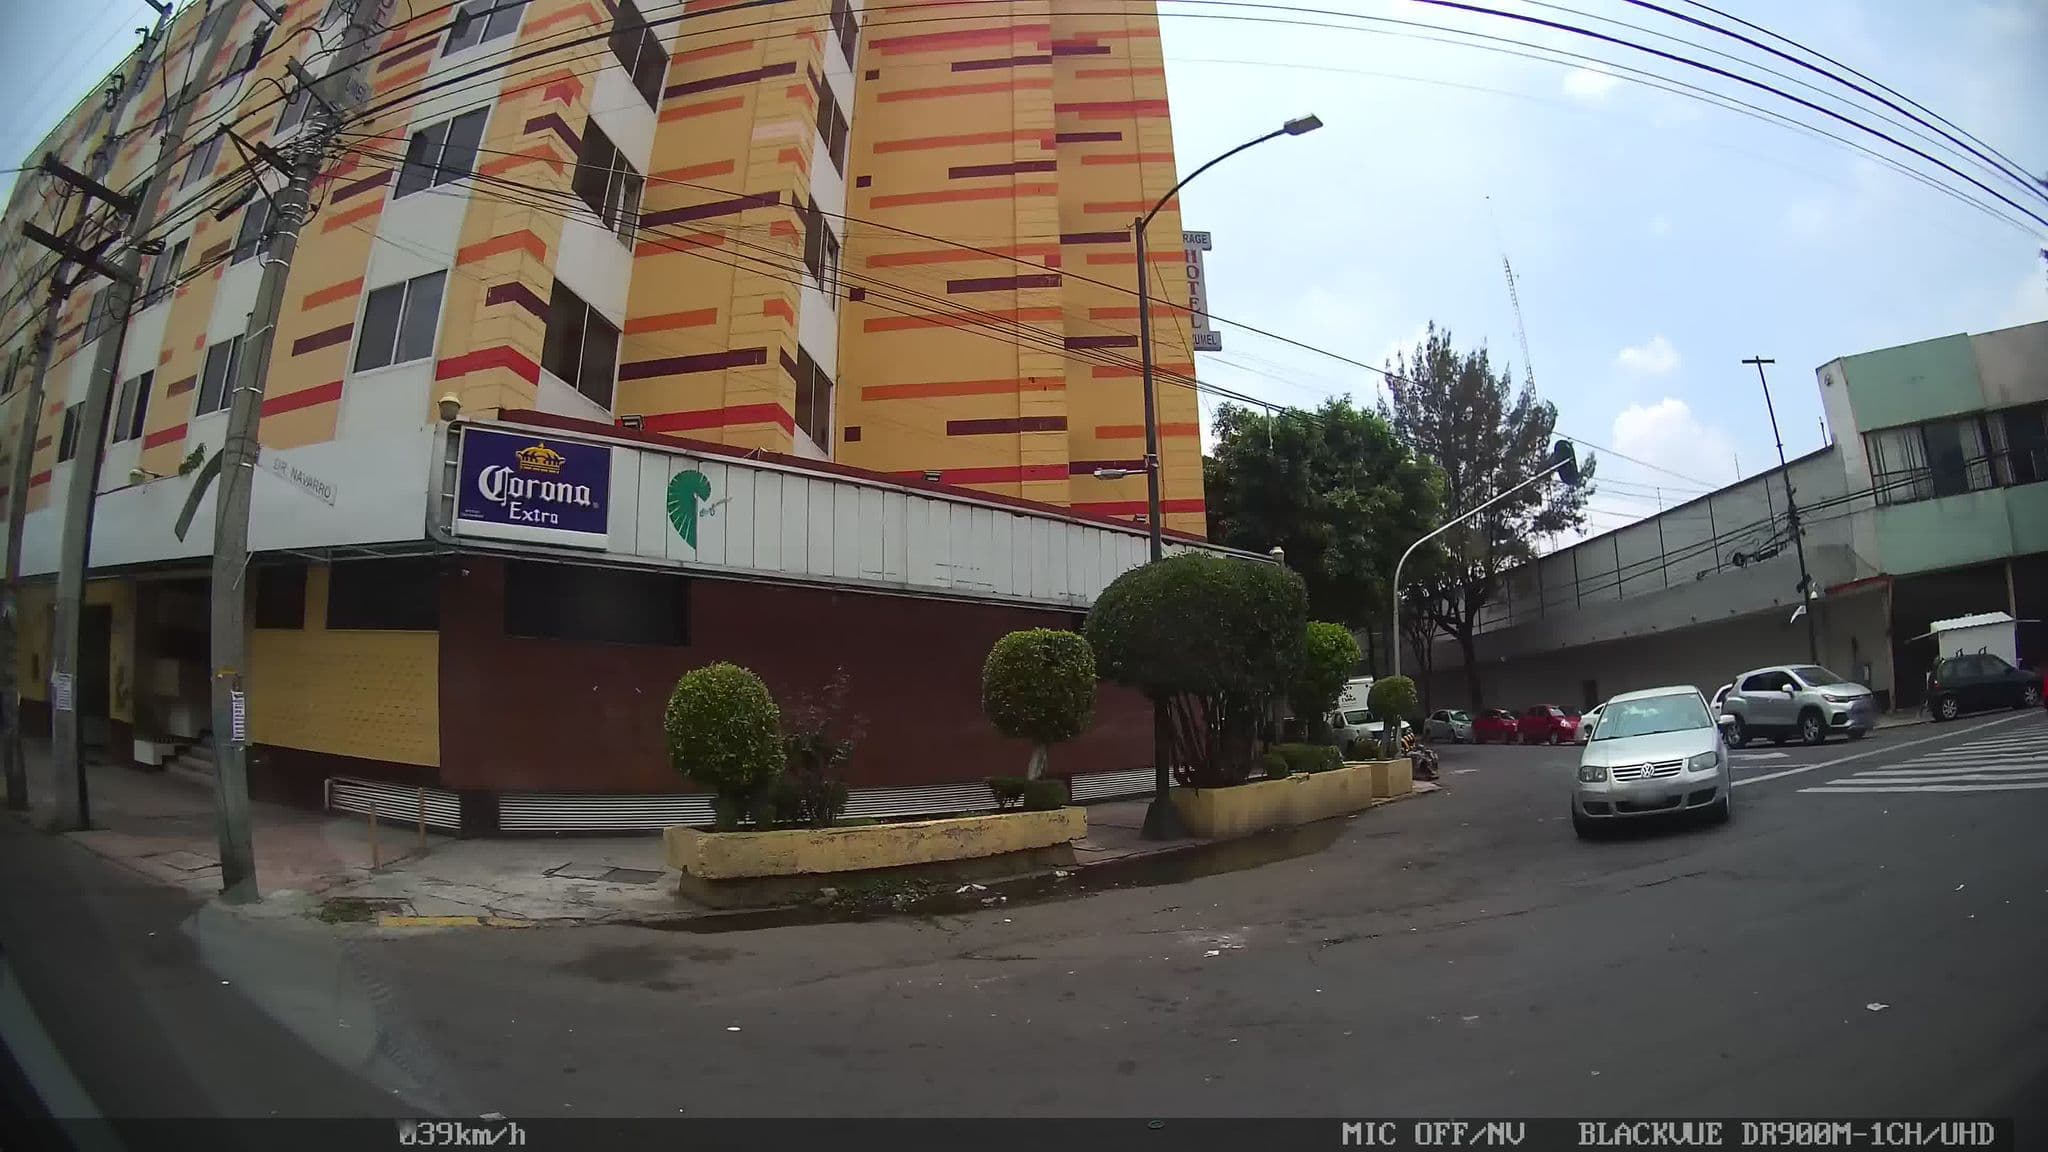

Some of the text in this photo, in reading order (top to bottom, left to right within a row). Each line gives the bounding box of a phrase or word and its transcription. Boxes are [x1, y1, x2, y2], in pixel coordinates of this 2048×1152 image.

[1184, 249, 1202, 328] HOTEL
[290, 467, 331, 498] NAVARRO
[478, 465, 592, 507] Corona
[509, 501, 559, 525] Extra
